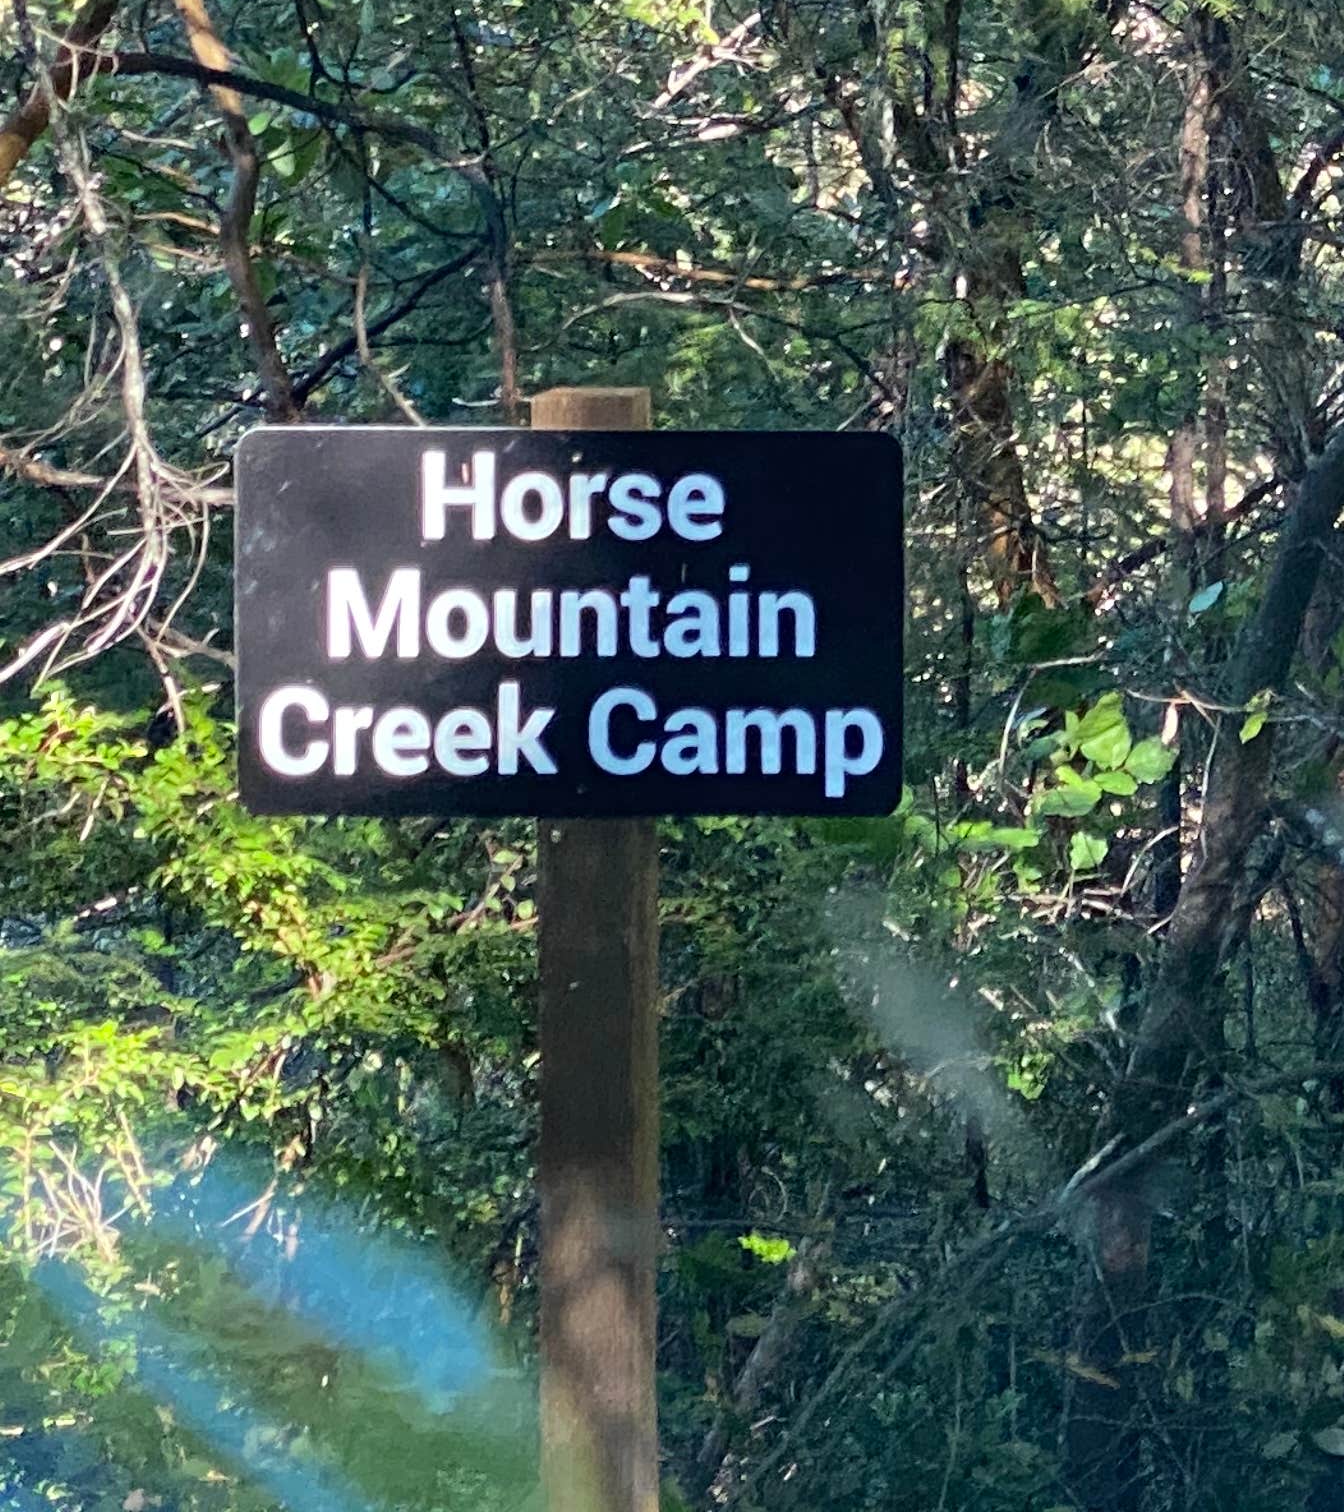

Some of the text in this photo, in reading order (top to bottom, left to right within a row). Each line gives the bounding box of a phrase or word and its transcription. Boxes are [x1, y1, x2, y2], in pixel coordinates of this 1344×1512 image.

[420, 448, 726, 542] Horse
[325, 564, 818, 659] Mountain
[257, 681, 884, 799] Creek Camp
